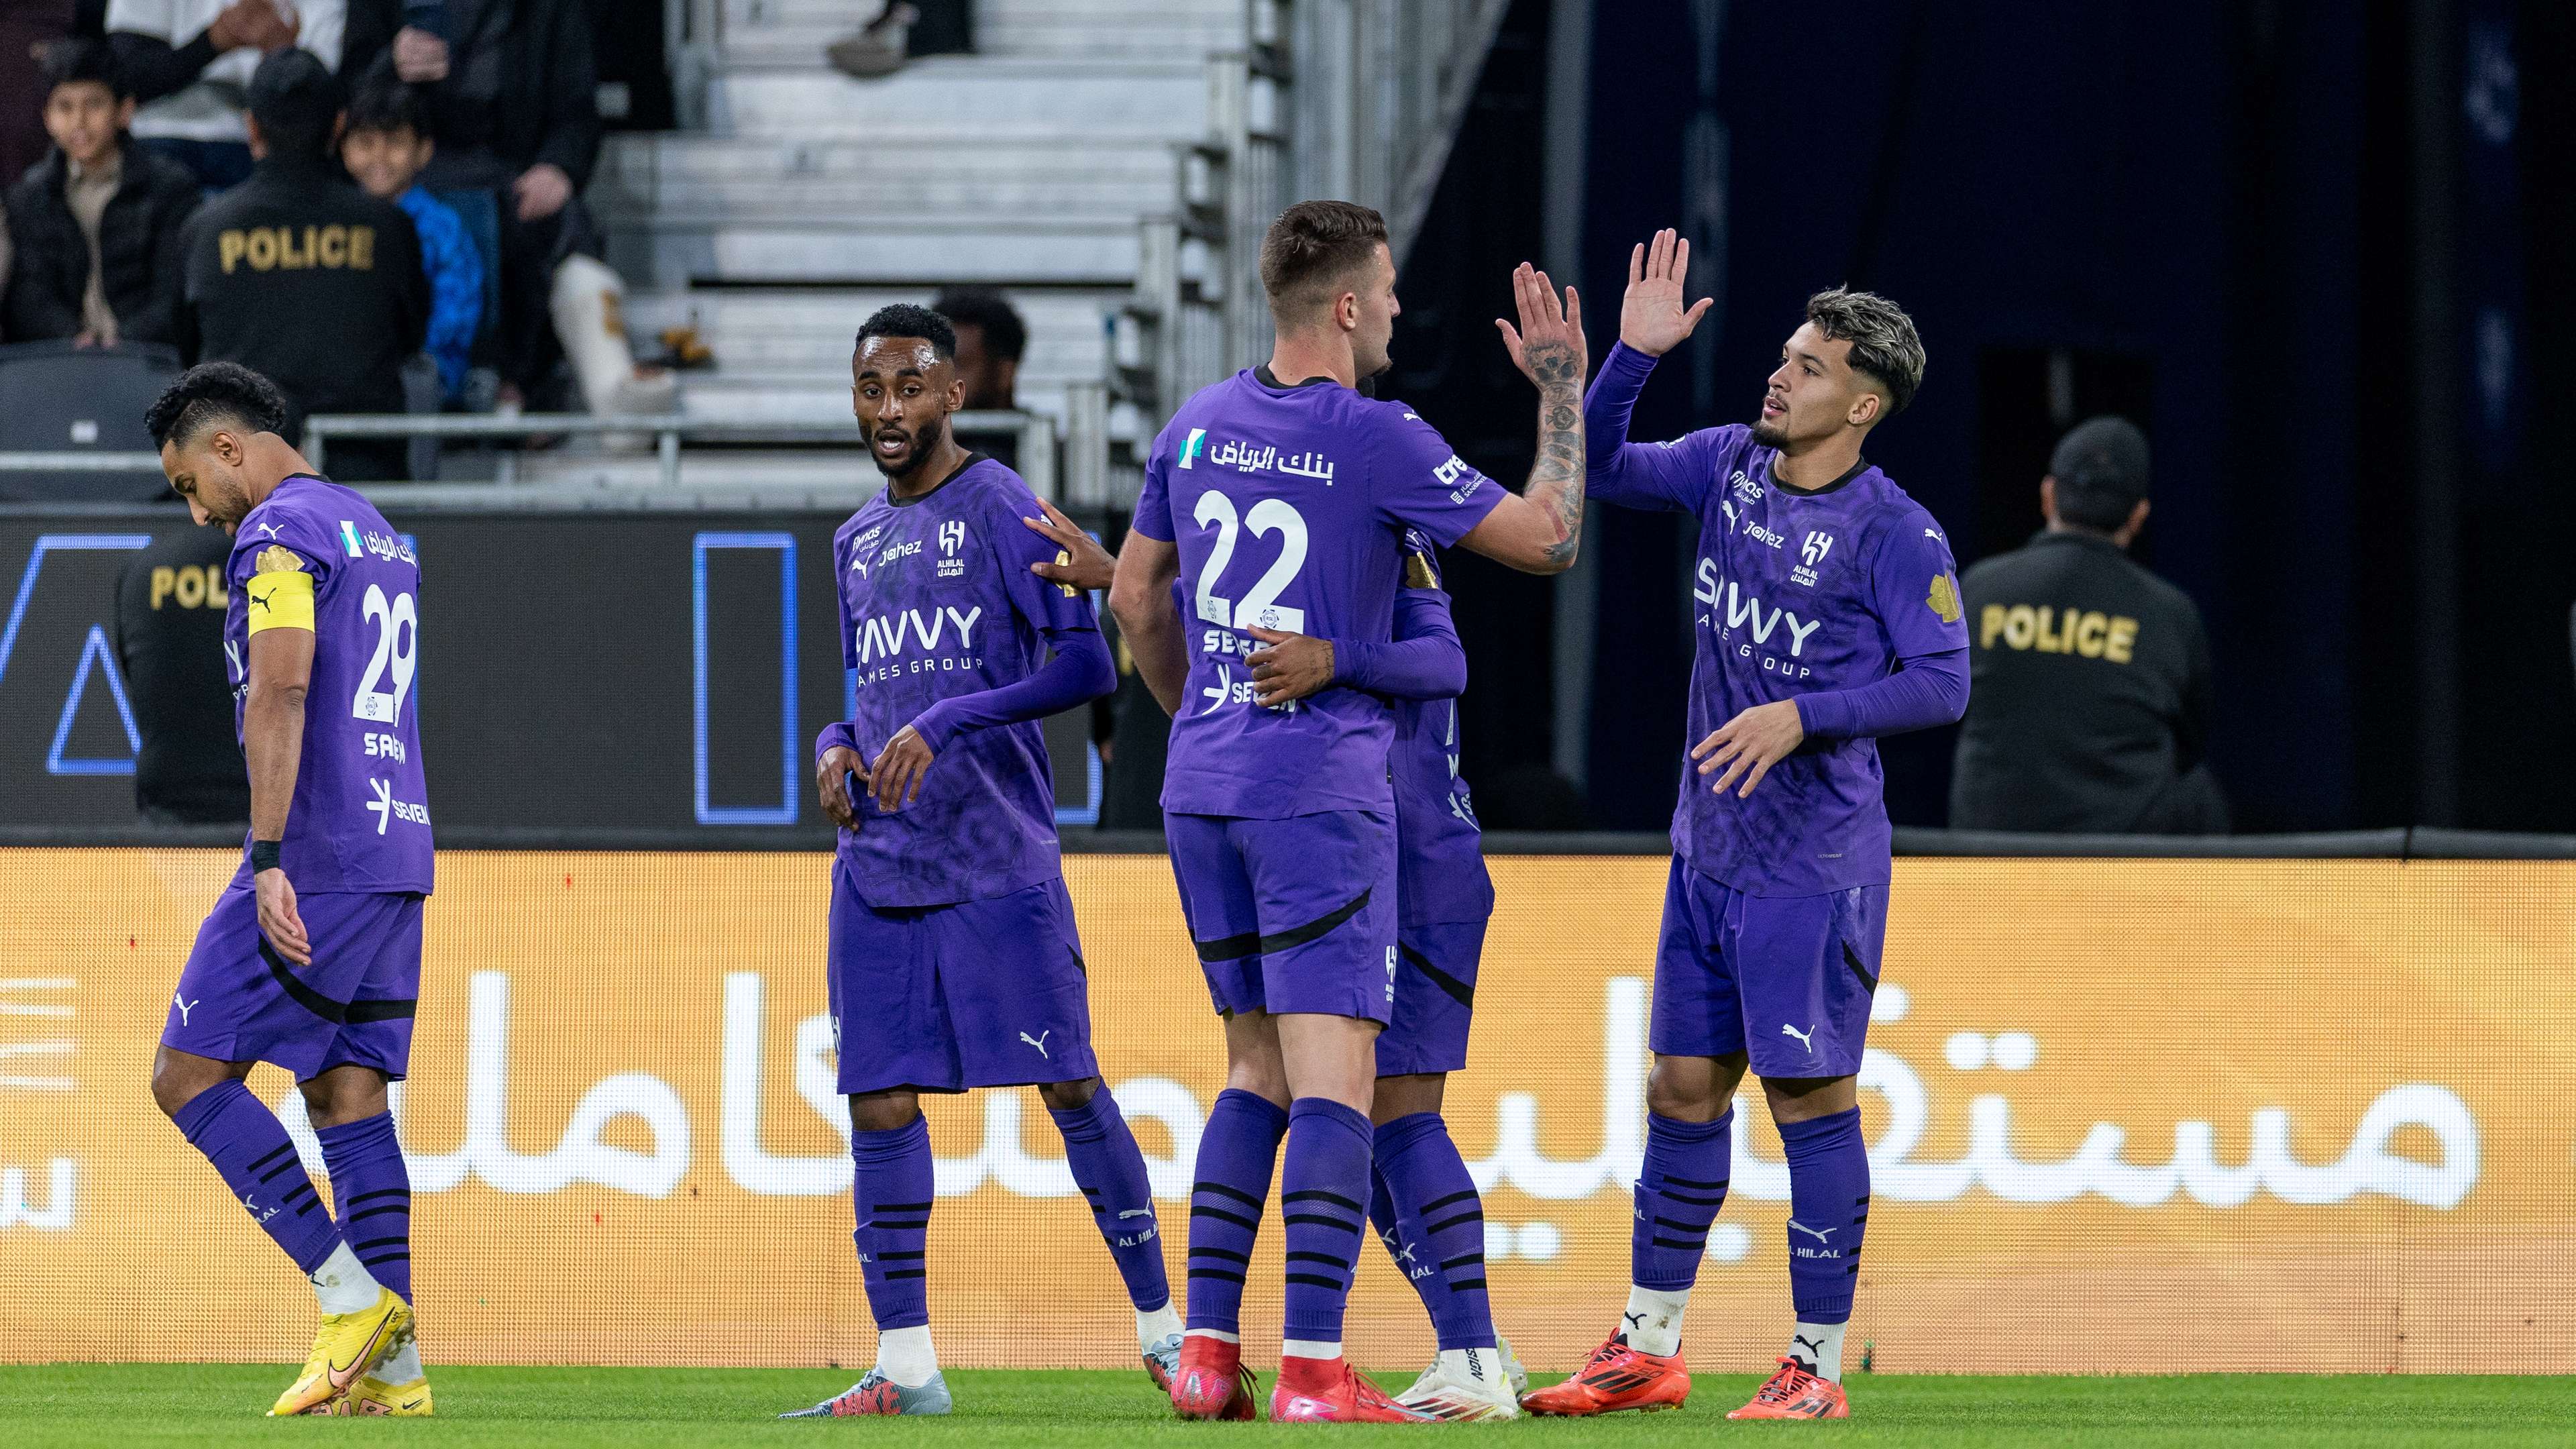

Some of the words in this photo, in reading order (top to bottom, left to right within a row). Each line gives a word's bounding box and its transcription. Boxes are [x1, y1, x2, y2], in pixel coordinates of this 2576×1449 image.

[219, 225, 376, 274] POLICE
[1211, 441, 1276, 472] الرياض
[1278, 451, 1334, 486] بنك
[1432, 454, 1468, 484] tre
[937, 559, 965, 568] ALHILAL
[938, 568, 963, 577] الهلال
[1193, 490, 1308, 635] 22
[1793, 565, 1818, 580] ALHILAL
[150, 565, 228, 610] POL
[1980, 604, 2139, 665] POLICE
[354, 584, 417, 728] 29
[858, 663, 900, 688] AMES
[910, 657, 983, 674] GROUP
[364, 732, 405, 765] SAEM
[392, 800, 431, 826] SEVEN
[1119, 1237, 1136, 1247] AL
[1797, 1248, 1841, 1258] HILAL
